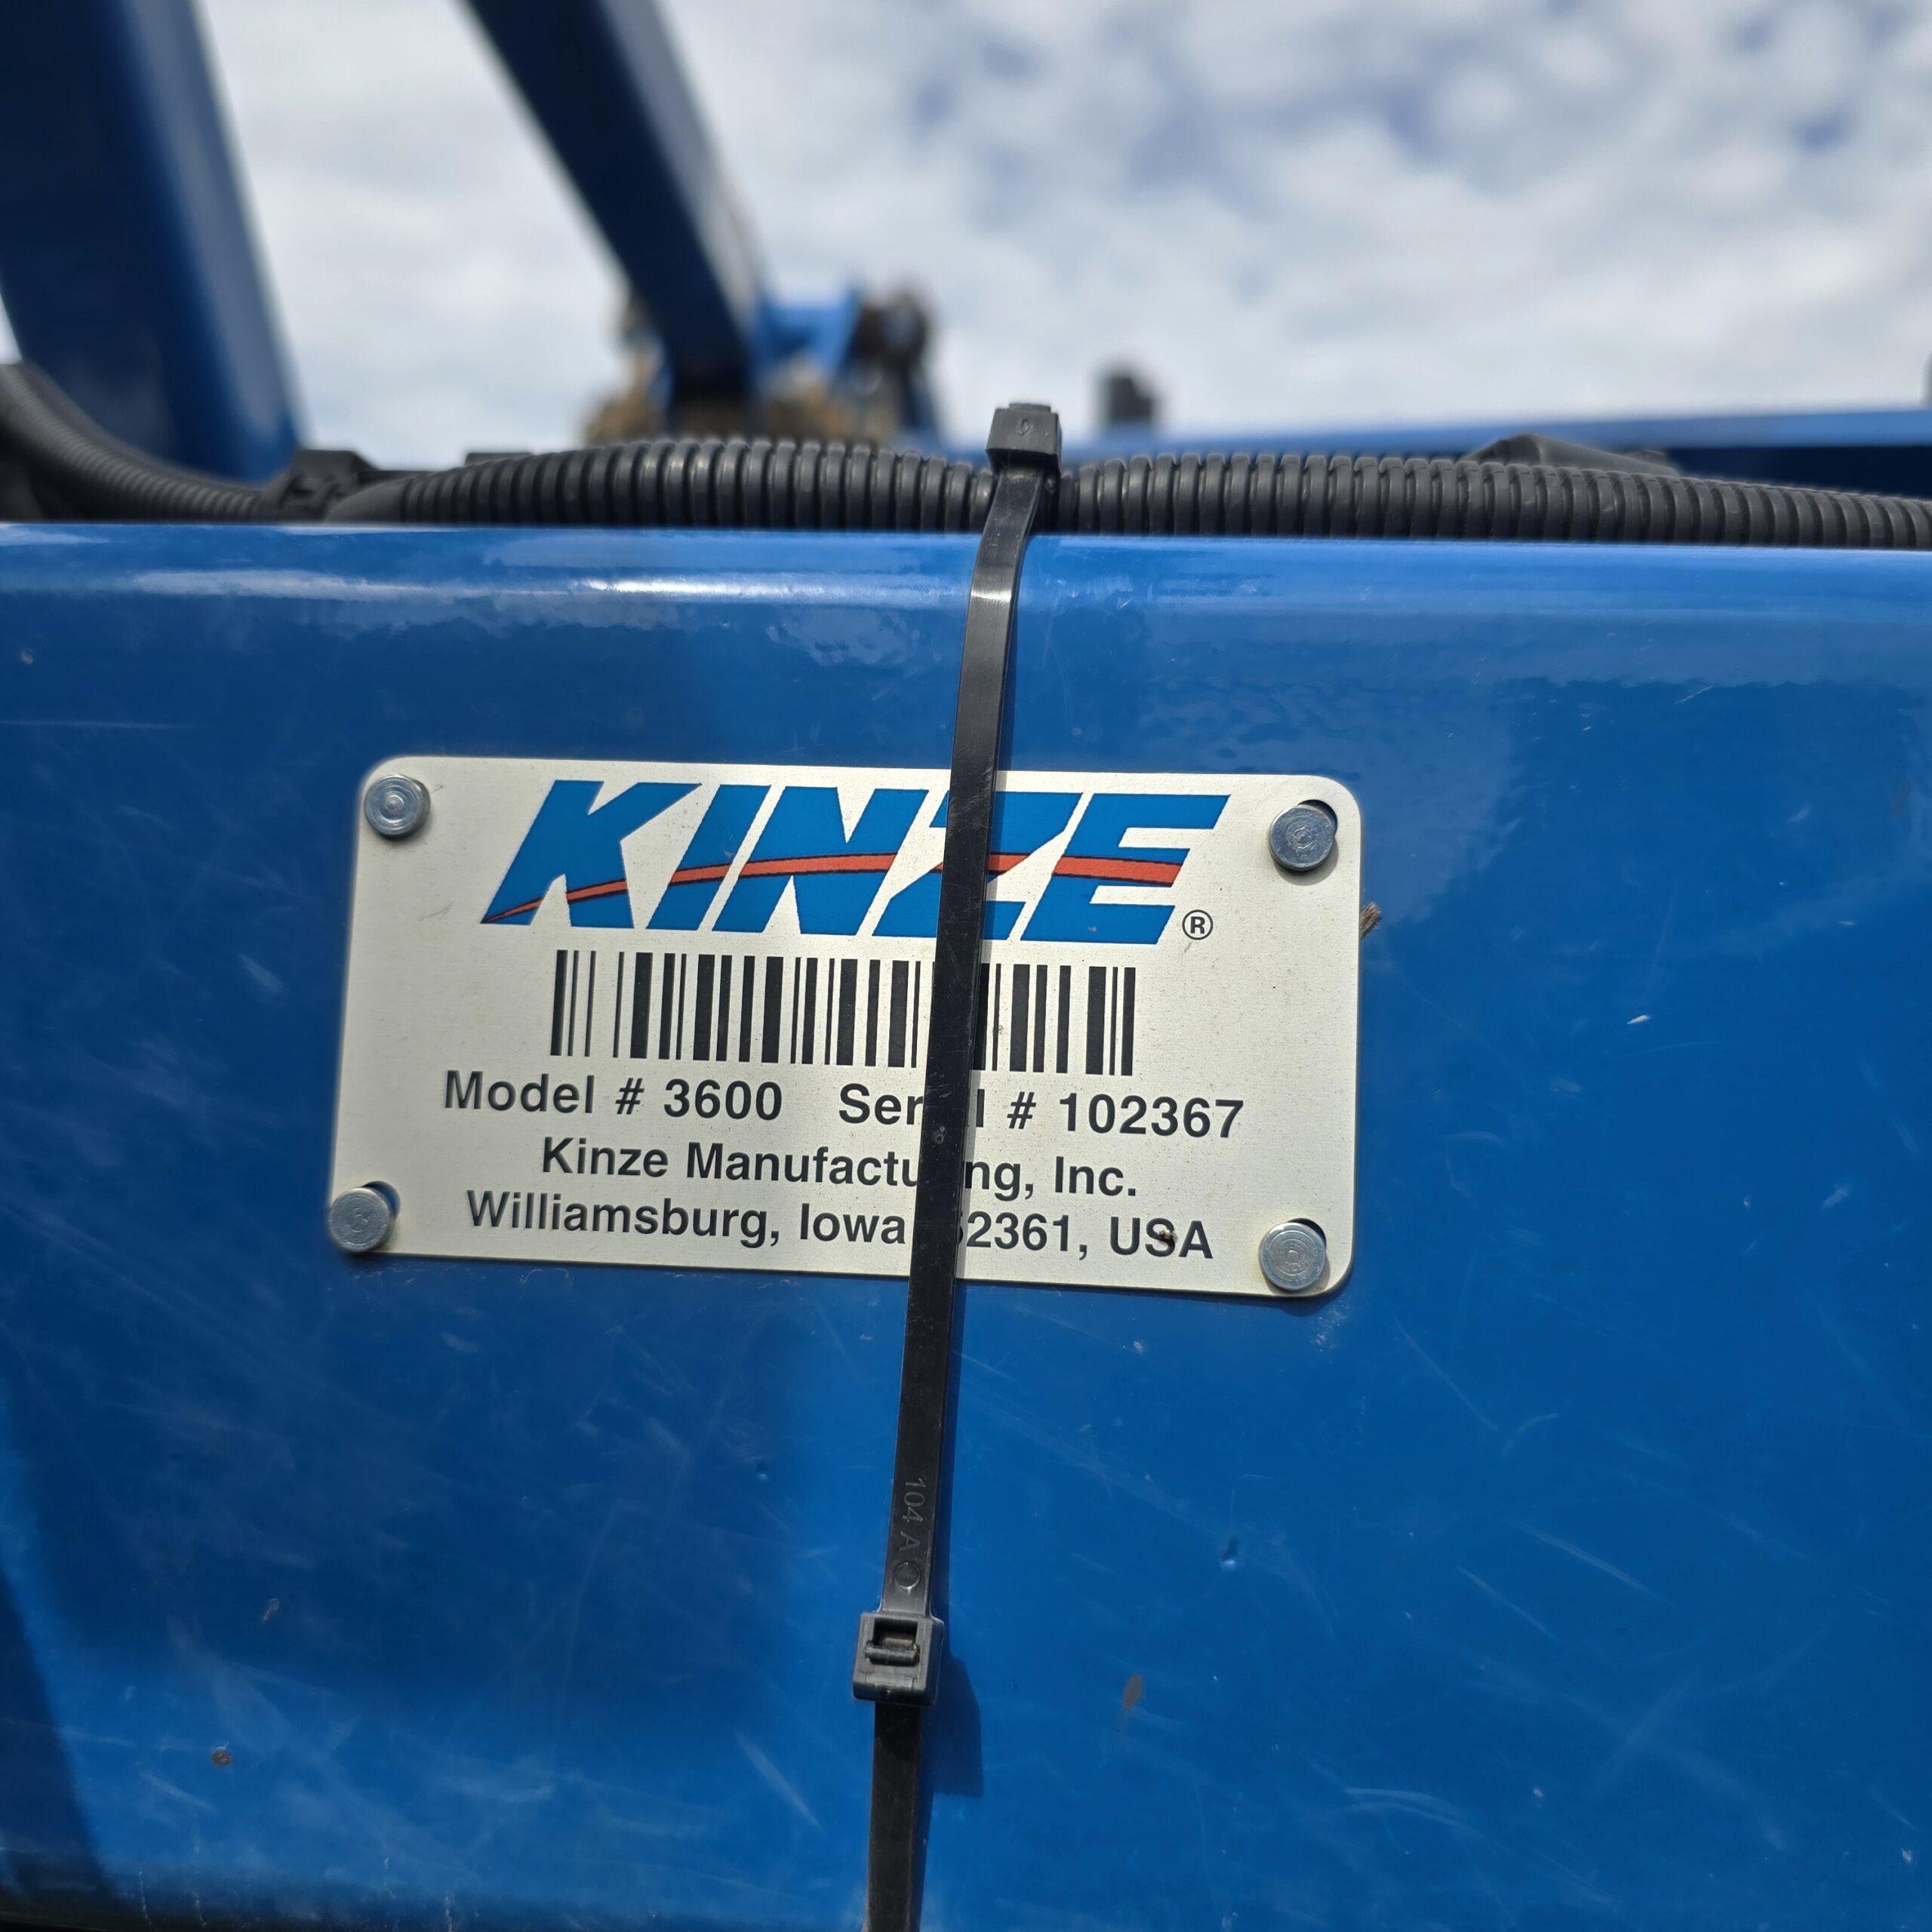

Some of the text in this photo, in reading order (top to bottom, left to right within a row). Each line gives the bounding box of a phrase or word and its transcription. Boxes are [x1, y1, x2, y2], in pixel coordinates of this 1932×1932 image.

[480, 780, 1230, 945] KINZE
[445, 1069, 1244, 1138] Model # 3600 Serl # 102367
[542, 1137, 1136, 1201] Kinze Manufactung, Inc.
[466, 1189, 1214, 1260] Williamsburg, Iowa 2361, USA
[899, 1477, 927, 1552] 104 A
